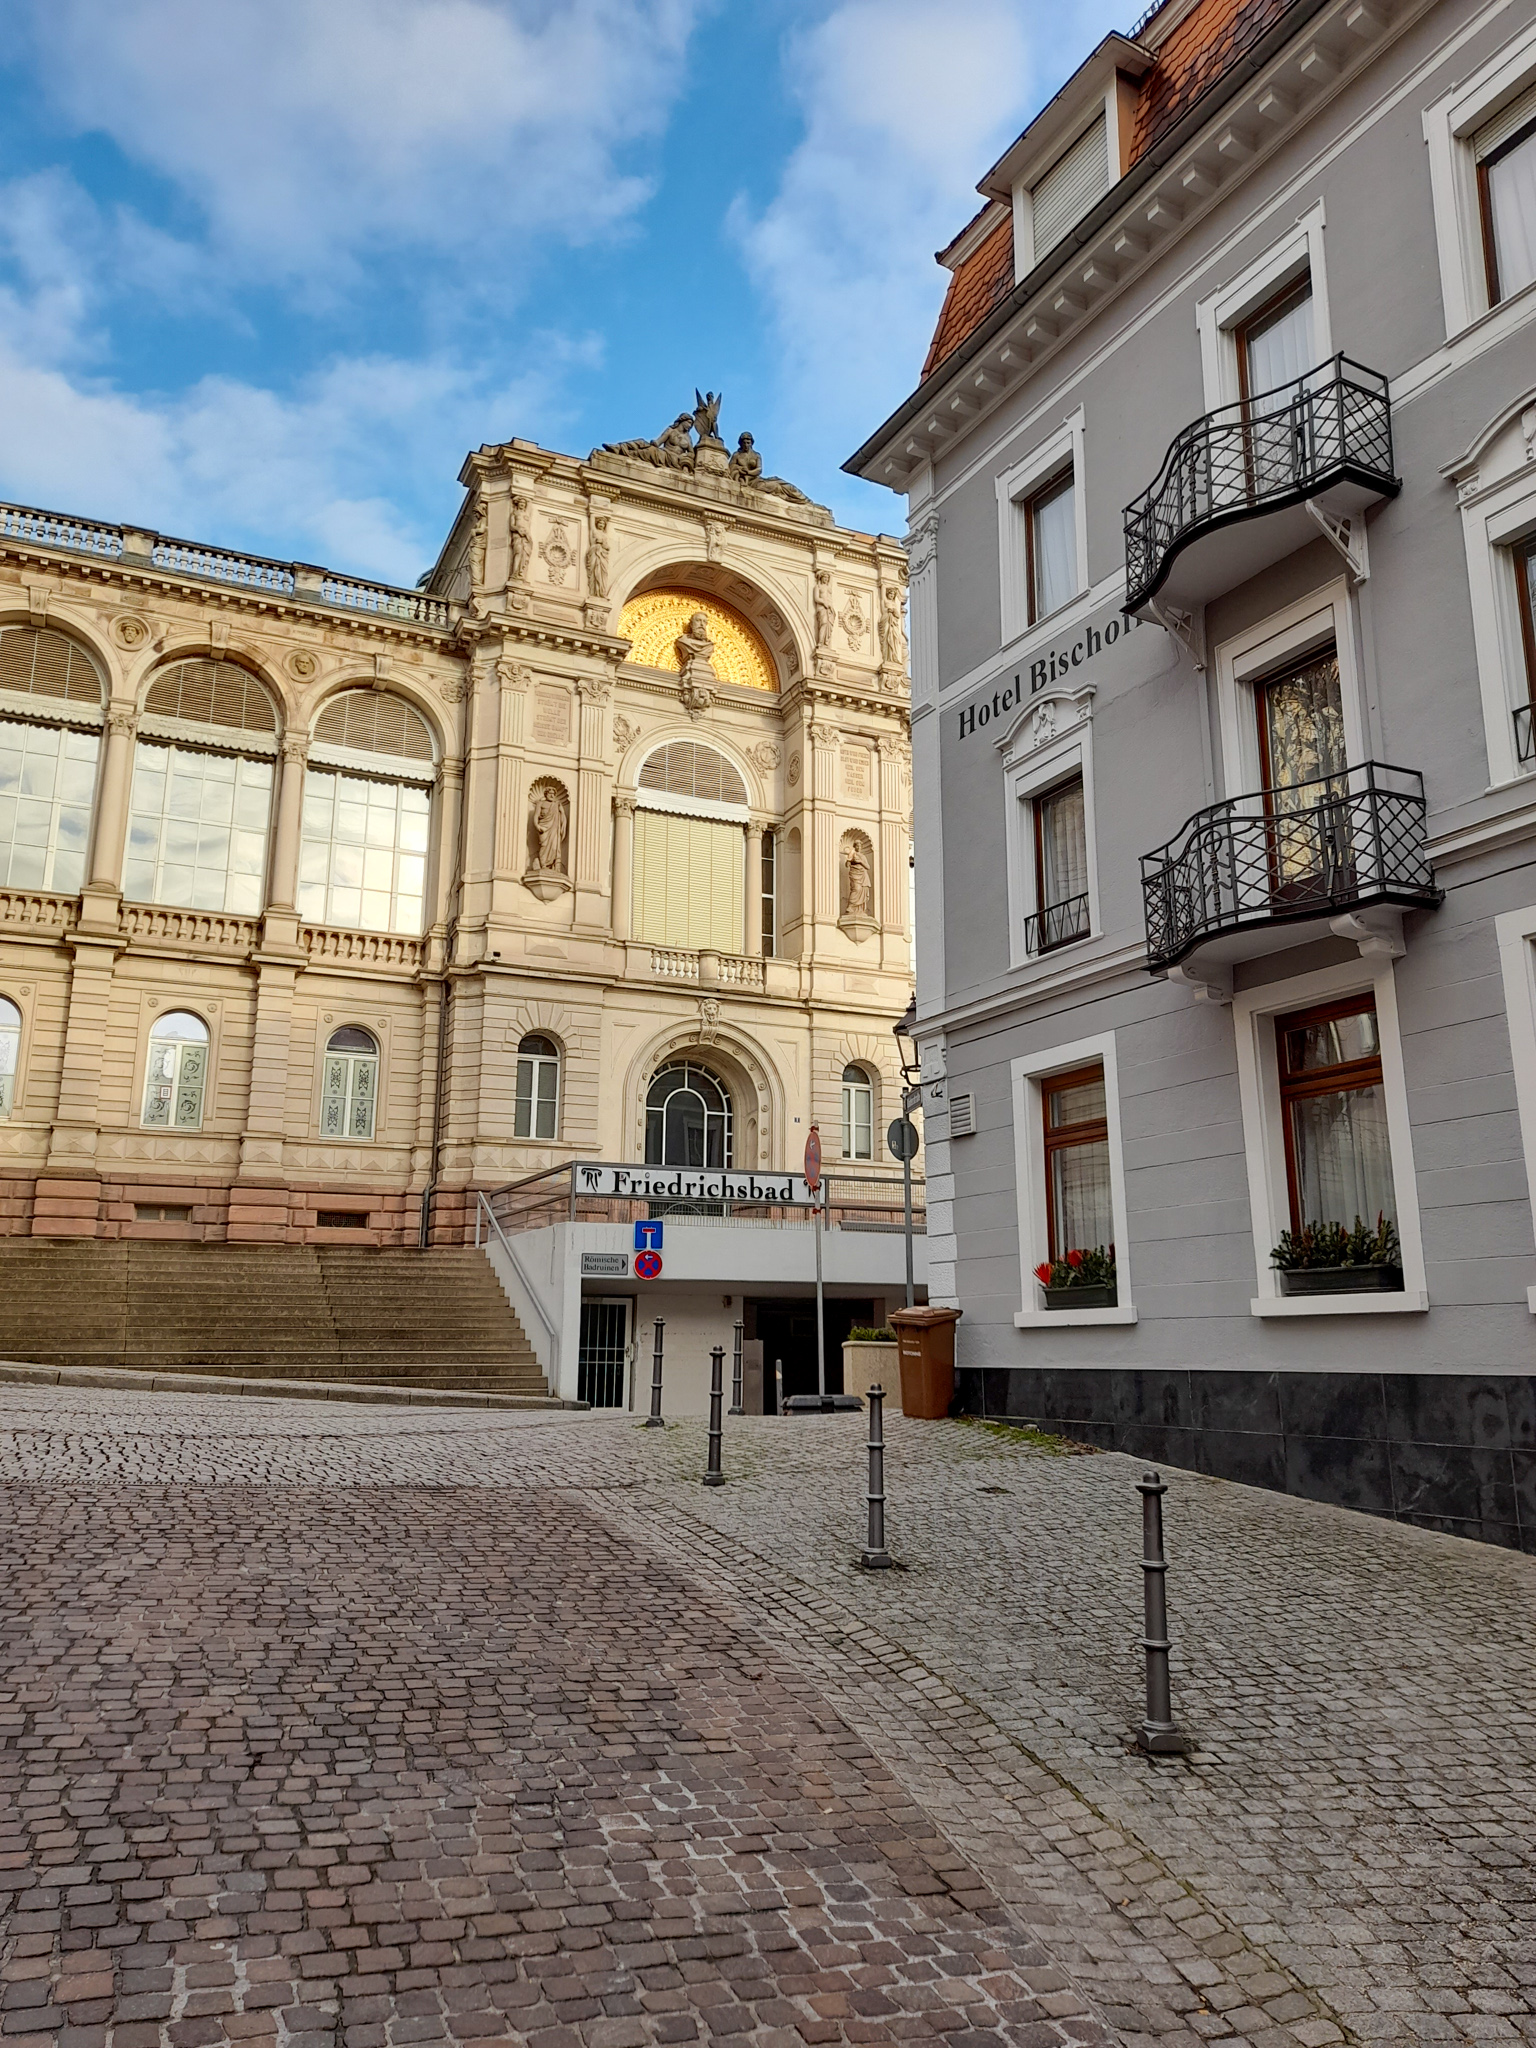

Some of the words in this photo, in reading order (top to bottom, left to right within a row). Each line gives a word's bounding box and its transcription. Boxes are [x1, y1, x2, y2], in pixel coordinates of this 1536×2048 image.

[957, 674, 1022, 742] Hotel
[1029, 613, 1145, 697] Bischof
[611, 1170, 795, 1201] Friedrichsbad
[584, 1255, 619, 1263] Römische
